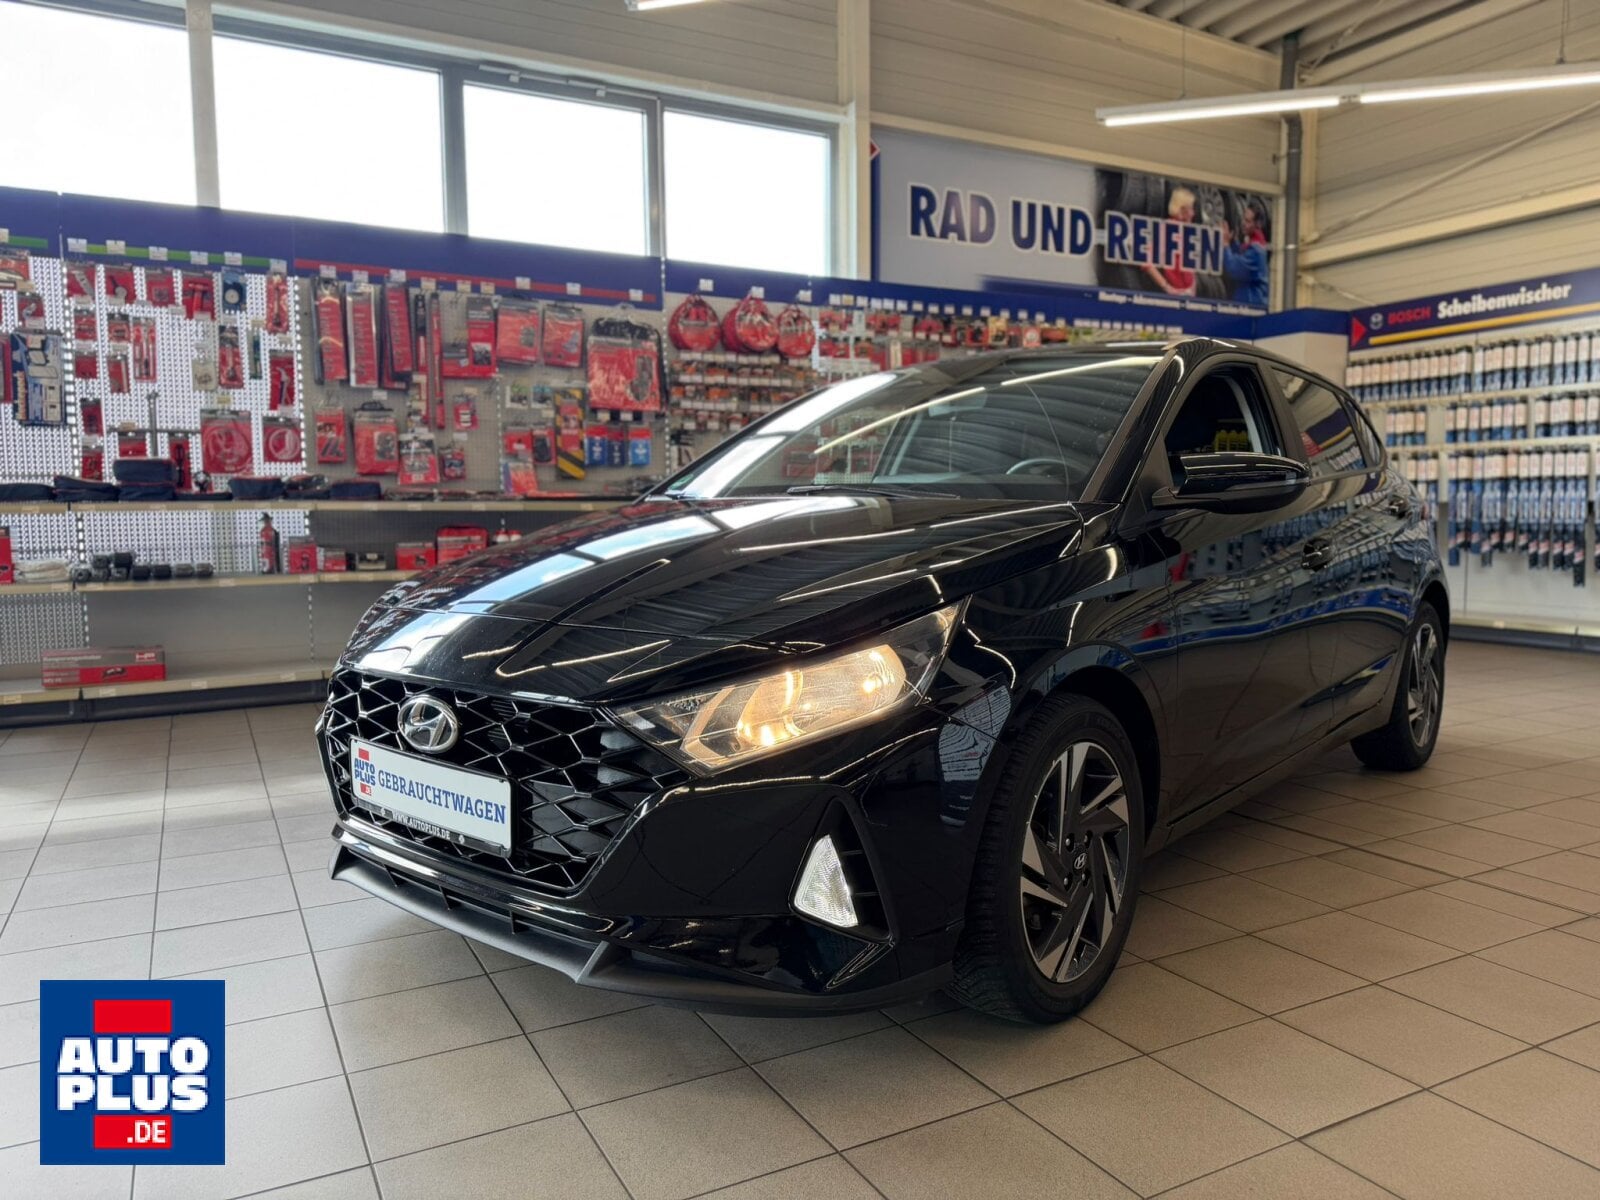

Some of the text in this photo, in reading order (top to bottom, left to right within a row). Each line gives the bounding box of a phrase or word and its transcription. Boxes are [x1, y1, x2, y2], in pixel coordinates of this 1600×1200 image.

[909, 184, 1224, 275] RAD UND REIFEN
[1387, 282, 1572, 325] BOSCH Scheibenwischer
[354, 757, 376, 774] AUTO
[354, 768, 376, 786] PLUS
[378, 769, 506, 824] GEBRAUCHTWAGEN
